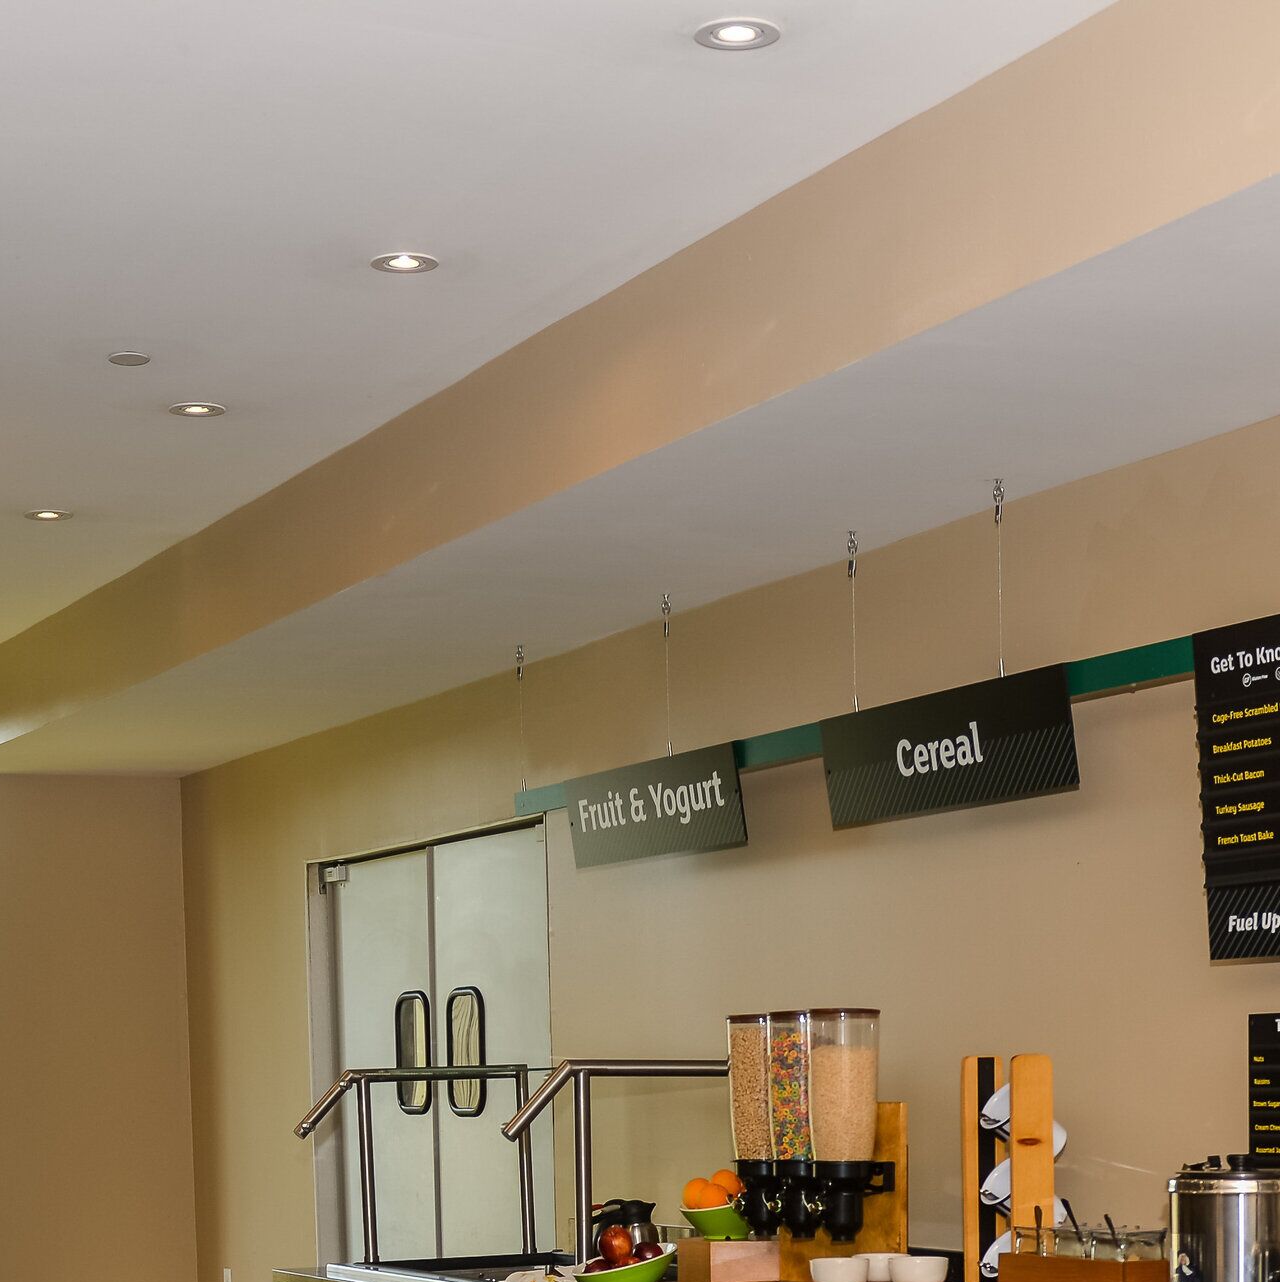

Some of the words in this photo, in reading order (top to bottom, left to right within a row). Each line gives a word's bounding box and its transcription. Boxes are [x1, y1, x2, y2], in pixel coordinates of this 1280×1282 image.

[1210, 654, 1235, 674] Get
[1236, 651, 1253, 668] To
[1212, 710, 1243, 723] Cage-Free
[1244, 702, 1278, 717] Scrambled
[896, 721, 984, 777] Cereal
[1212, 740, 1242, 754] Breakfast
[1243, 737, 1272, 749] Potatoes
[1213, 772, 1243, 784] Thick-Cut
[1244, 769, 1265, 780] Bacon
[578, 790, 626, 833] Fruit
[630, 787, 647, 823] &
[648, 770, 725, 825] Yogurt
[1215, 805, 1237, 815] Turkey
[1238, 801, 1265, 812] Sausage
[1217, 835, 1238, 845] French
[1240, 832, 1256, 843] Toast
[1258, 830, 1274, 840] Bake
[1228, 912, 1258, 932] Fuel
[1261, 912, 1280, 933] Up
